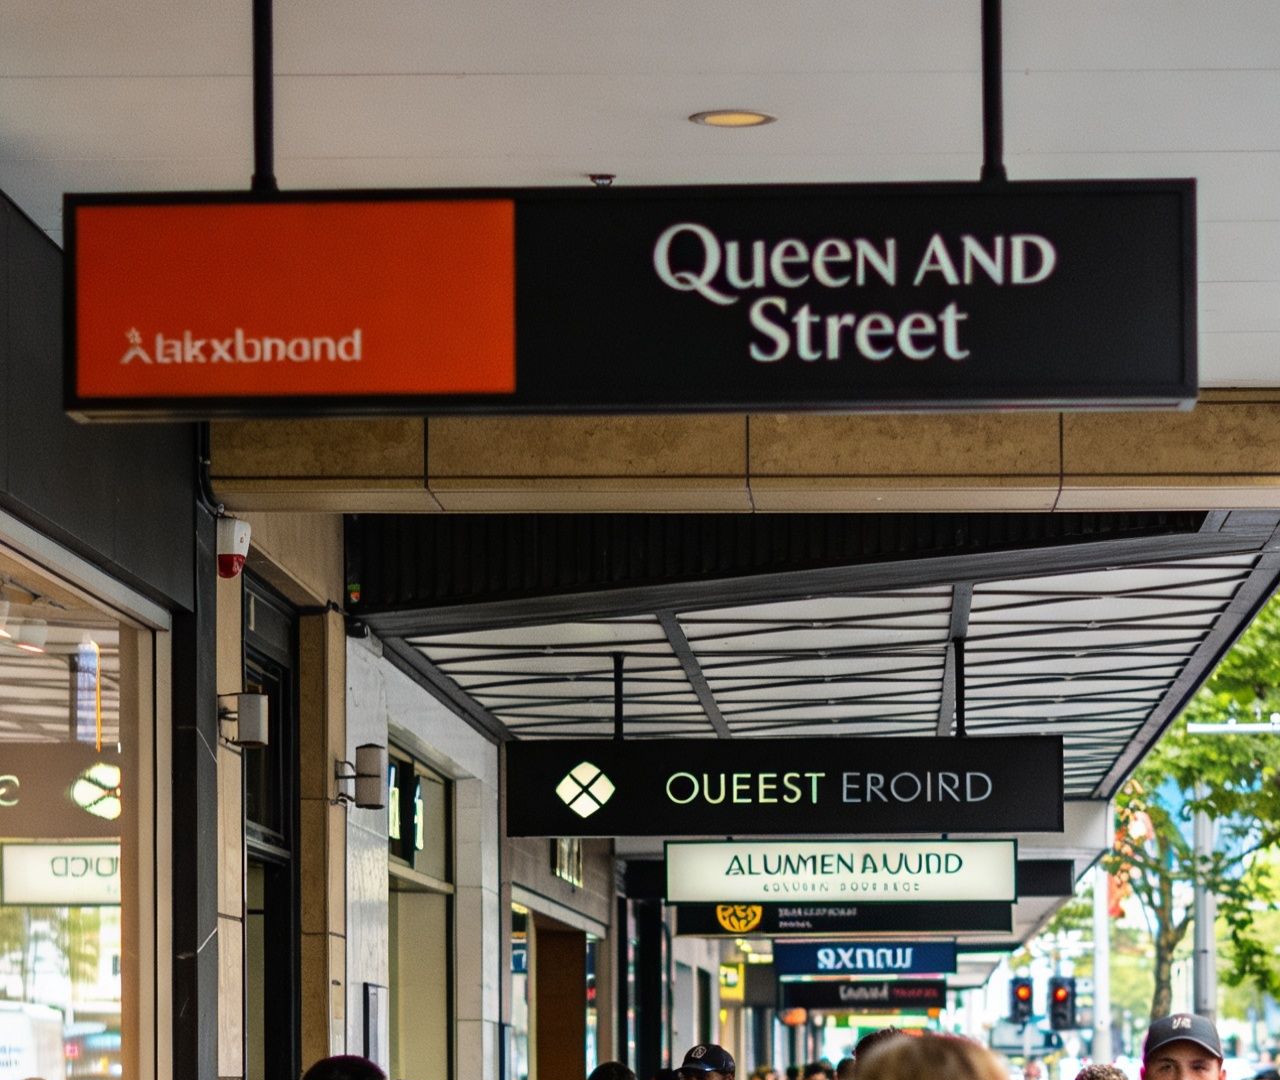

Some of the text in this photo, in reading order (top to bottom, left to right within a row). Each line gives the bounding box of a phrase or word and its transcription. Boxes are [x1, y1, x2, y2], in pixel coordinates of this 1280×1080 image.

[913, 233, 1057, 286] AND
[748, 295, 970, 362] Street
[842, 771, 993, 802] EROIRD
